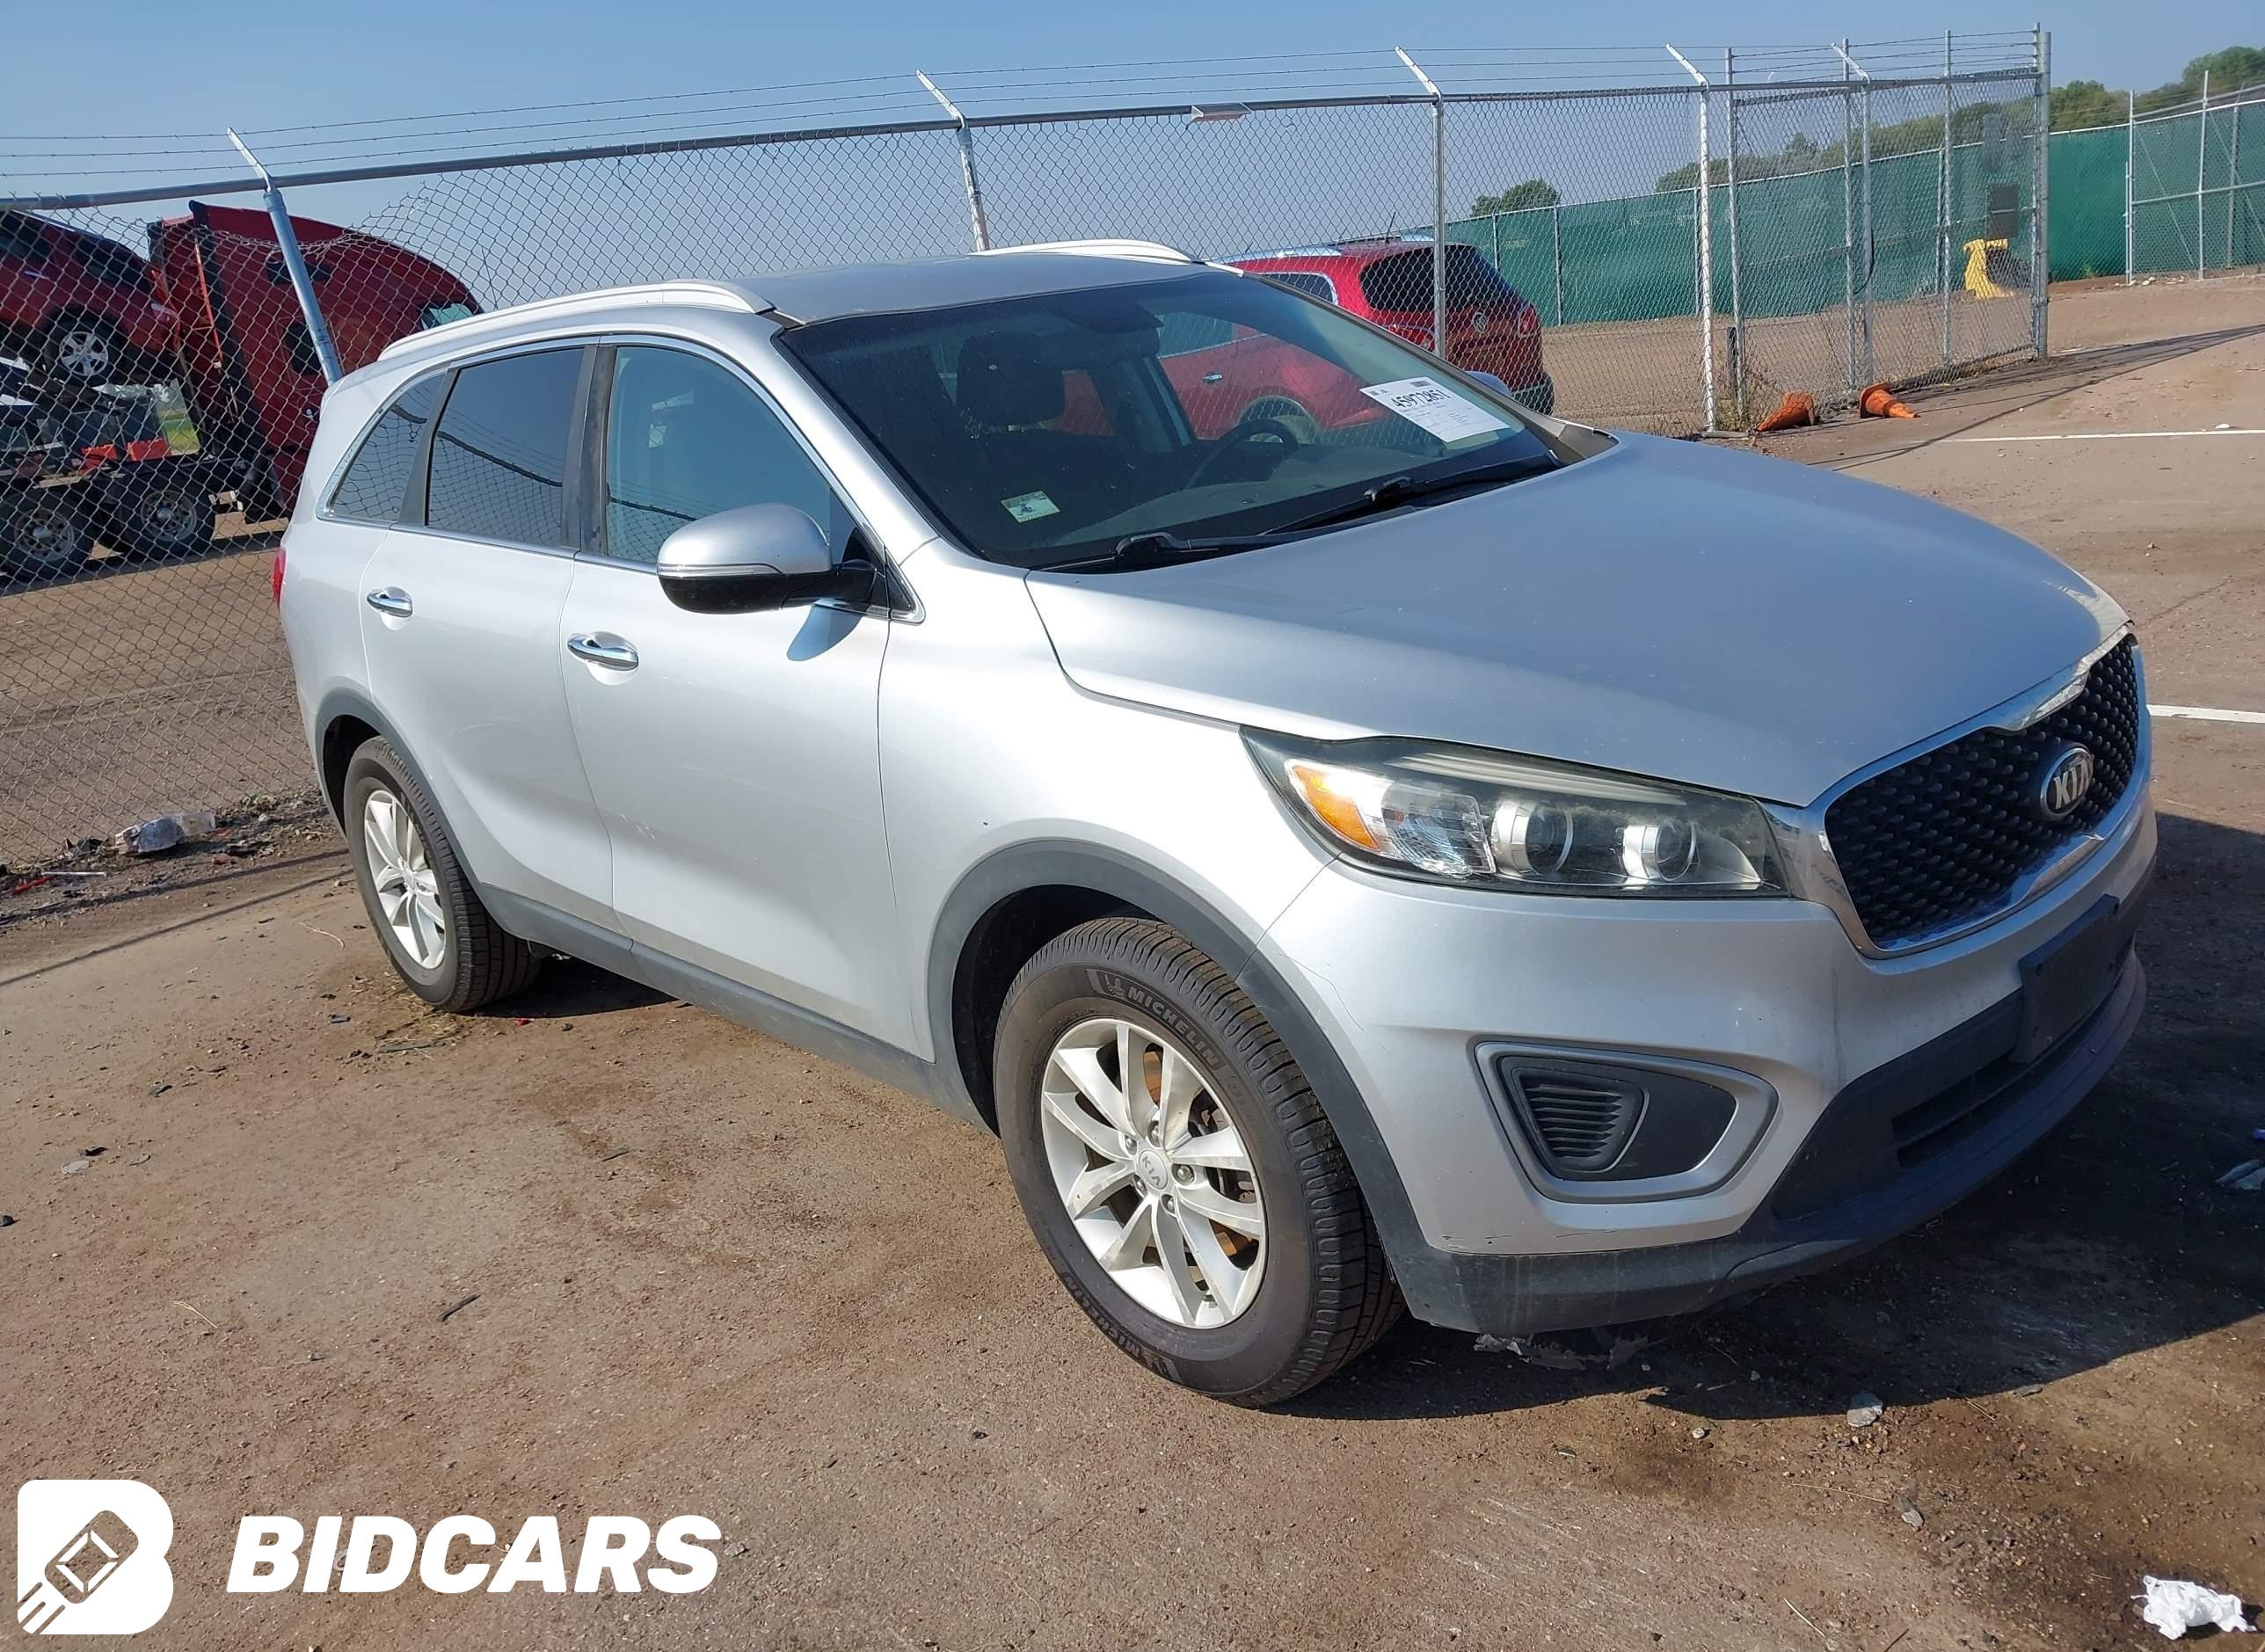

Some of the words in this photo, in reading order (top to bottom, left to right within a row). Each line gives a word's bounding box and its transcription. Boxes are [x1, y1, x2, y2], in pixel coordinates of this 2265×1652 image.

[1390, 389, 1452, 408] 45972851
[2053, 760, 2089, 810] KIA
[1128, 986, 1219, 1066] MICHELIN
[1142, 1155, 1161, 1186] KIA
